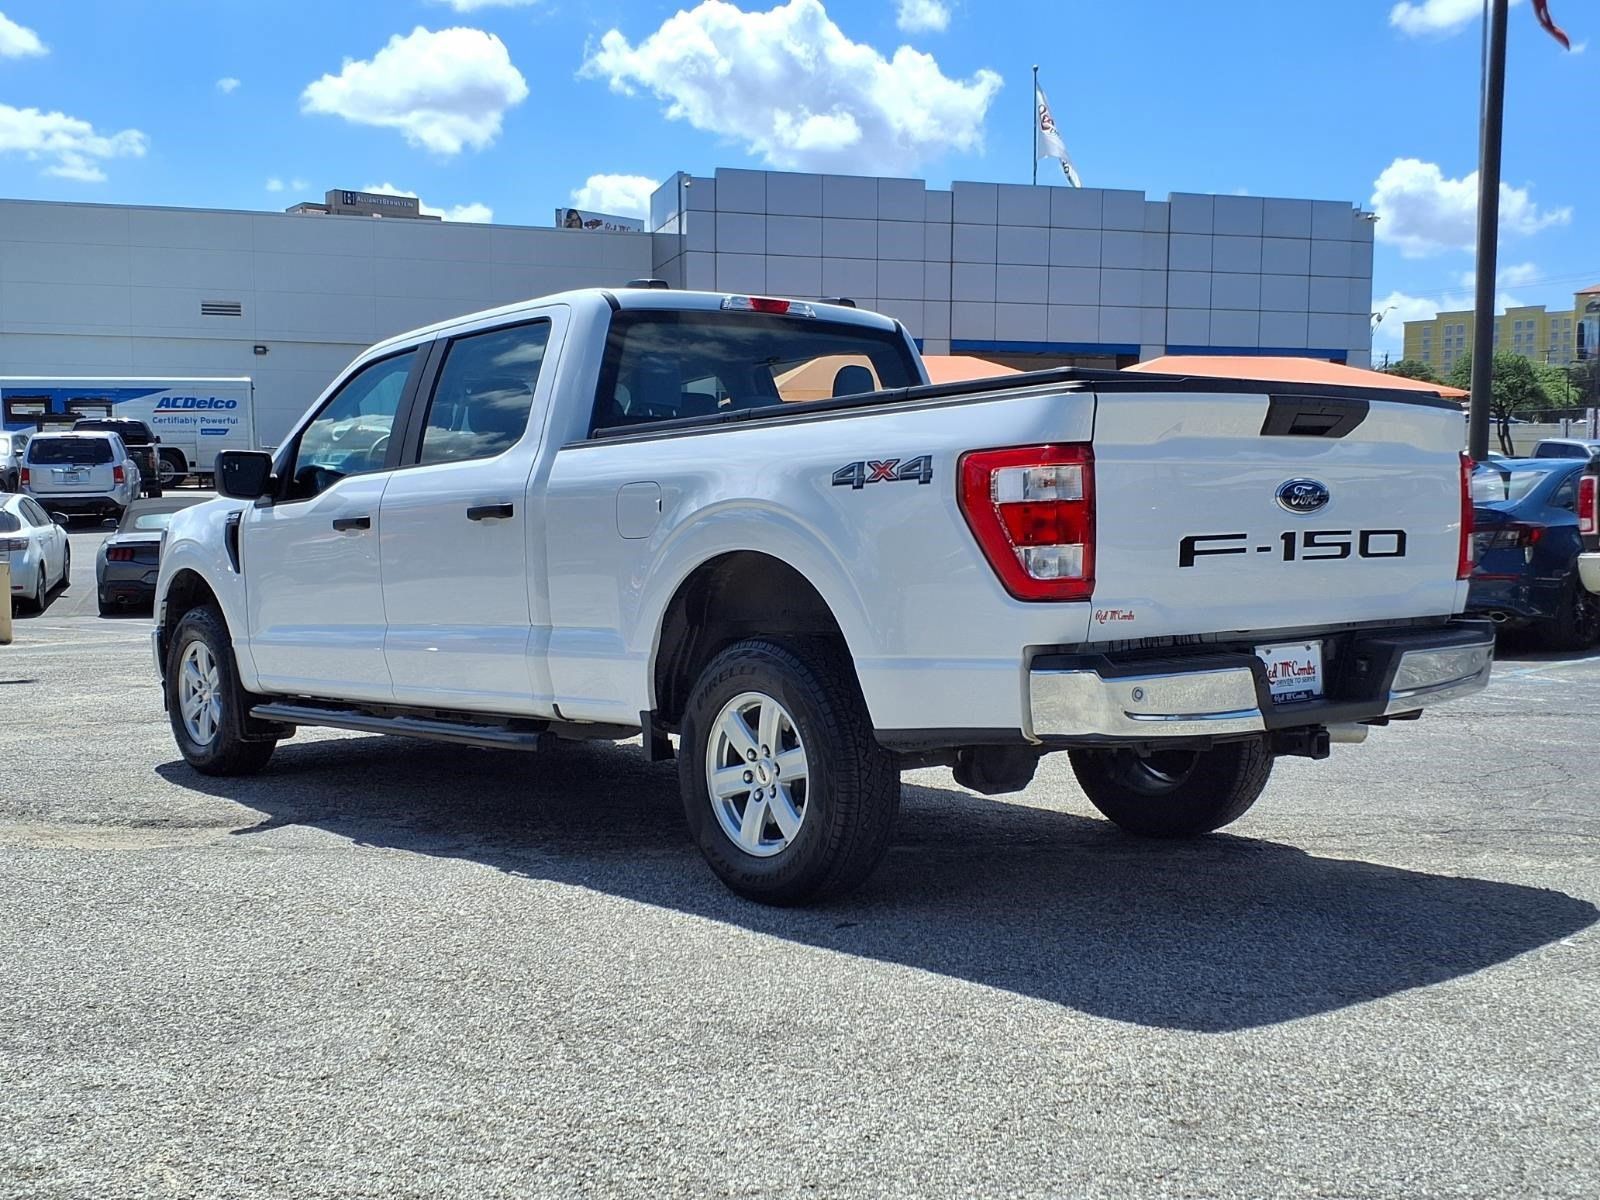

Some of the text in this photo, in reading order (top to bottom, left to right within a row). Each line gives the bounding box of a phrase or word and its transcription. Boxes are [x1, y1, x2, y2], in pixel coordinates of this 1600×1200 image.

[156, 397, 237, 409] ACDelco
[152, 416, 239, 426] Certifiably Powerful
[1291, 485, 1320, 505] Ford
[1179, 529, 1407, 567] F-150
[1095, 609, 1109, 624] Red
[1279, 660, 1316, 678] McCombs
